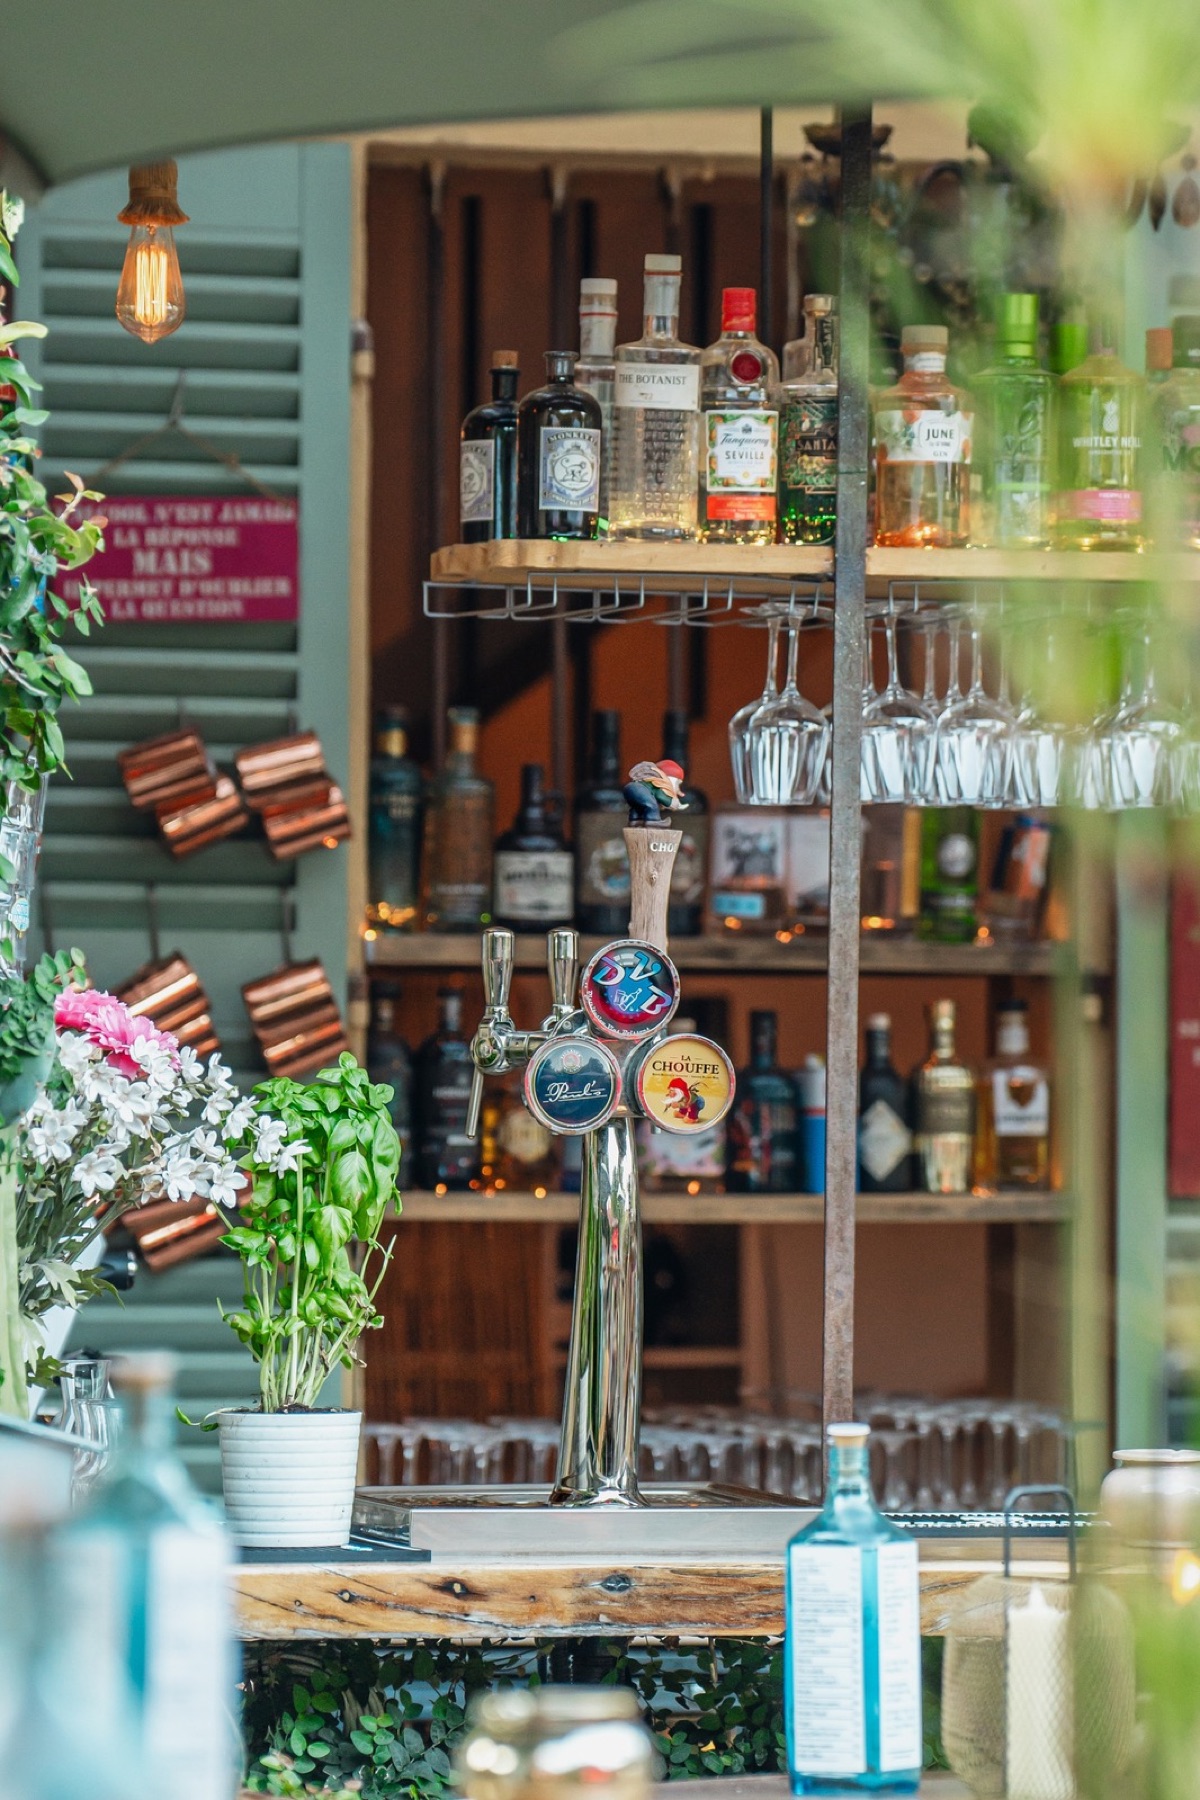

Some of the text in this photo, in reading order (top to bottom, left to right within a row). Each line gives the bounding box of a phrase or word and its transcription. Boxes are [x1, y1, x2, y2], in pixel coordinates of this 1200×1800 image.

[619, 373, 687, 386] THE BOTANIST
[720, 433, 769, 447] Tanqueray
[926, 429, 955, 440] JUNE
[798, 439, 837, 450] SANTA
[1073, 436, 1119, 448] WHITLEY
[725, 450, 765, 460] SEVILLA
[113, 527, 139, 547] LA
[132, 549, 214, 575] MAIS
[650, 842, 678, 854] CHO
[652, 1061, 720, 1075] CHOUFFE
